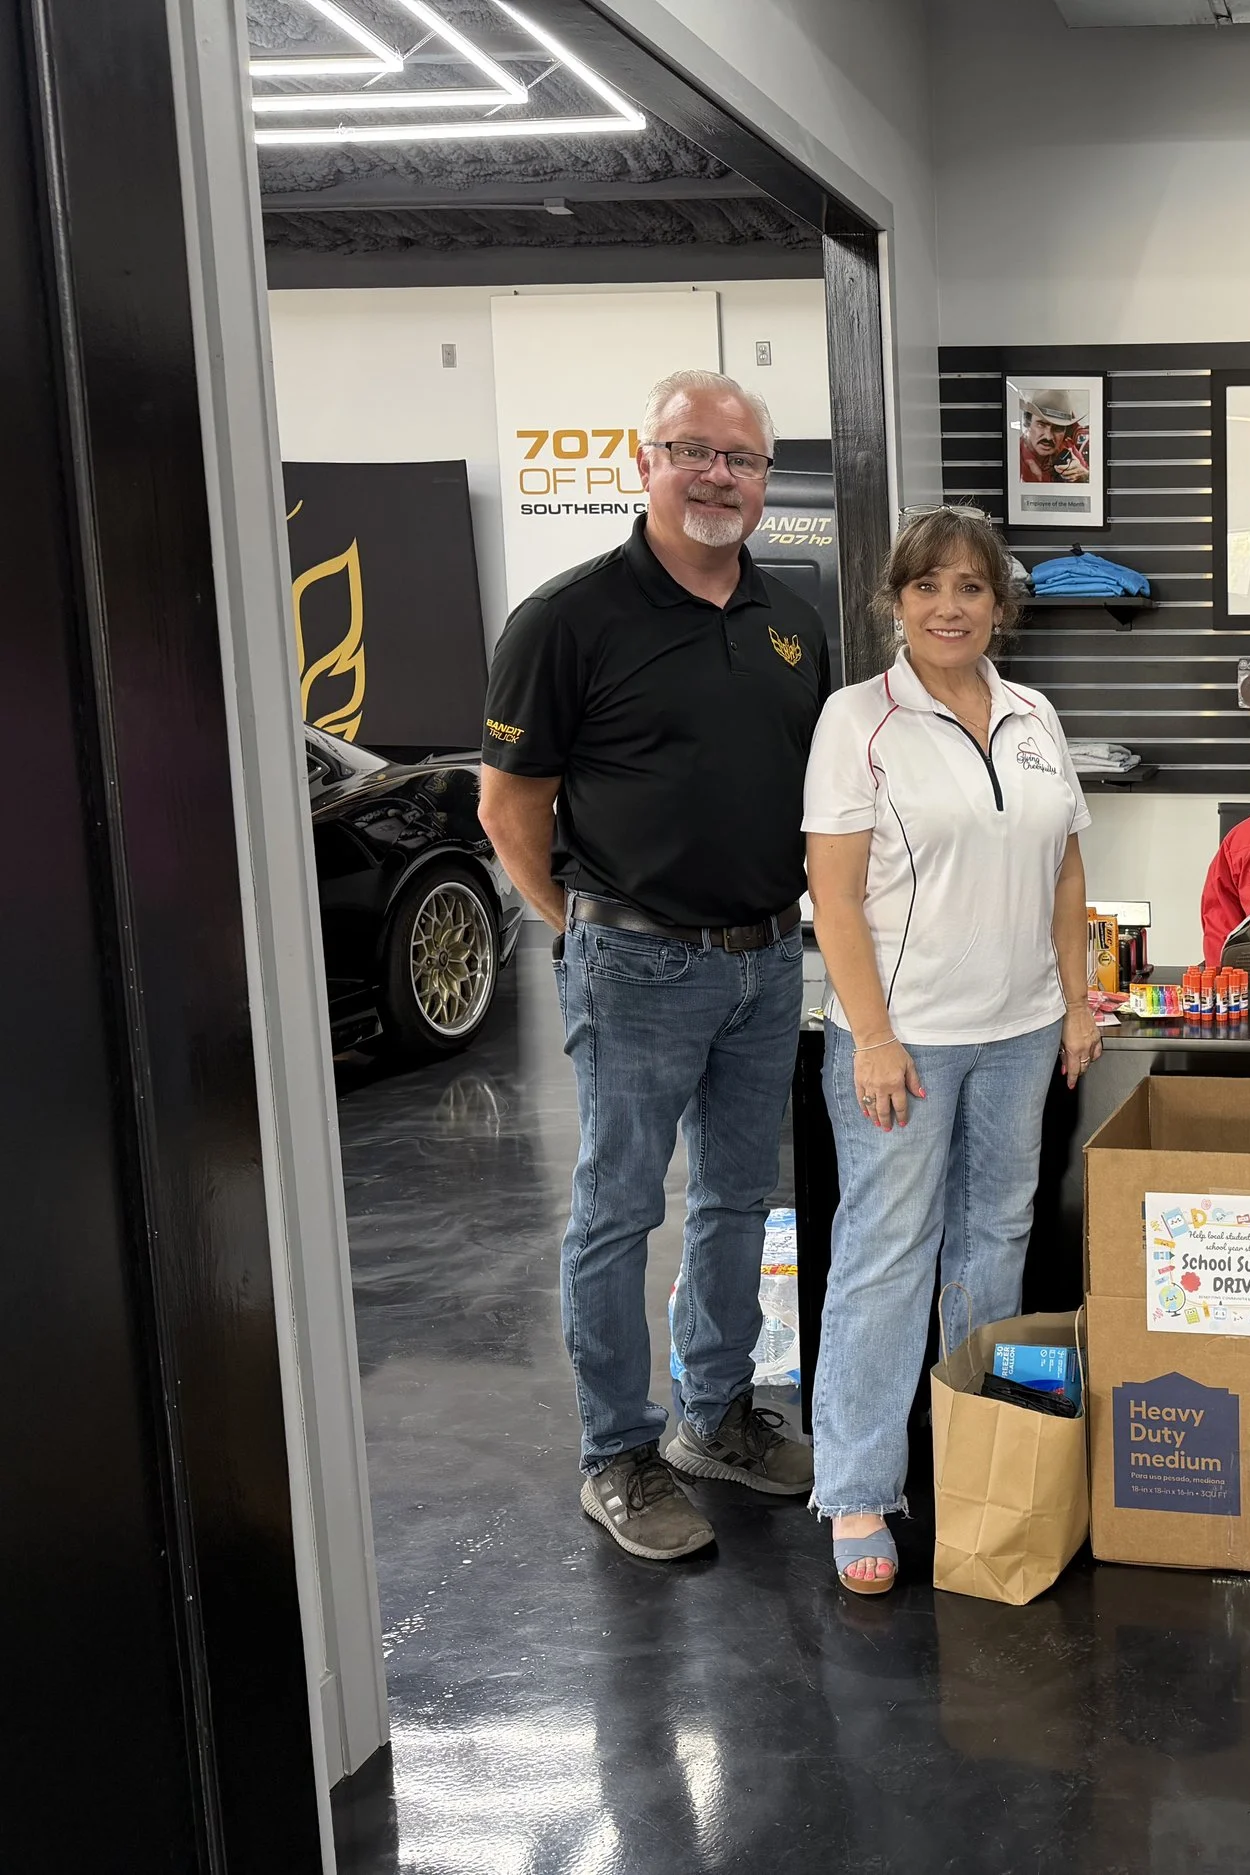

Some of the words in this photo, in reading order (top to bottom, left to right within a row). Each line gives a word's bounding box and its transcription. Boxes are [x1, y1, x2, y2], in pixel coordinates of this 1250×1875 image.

[520, 468, 576, 494] OF
[521, 503, 628, 514] SOUTHERN
[755, 517, 832, 532] ANDIT
[486, 718, 524, 736] BANDIT
[490, 728, 520, 744] TRUCK
[1188, 1230, 1206, 1242] Help
[1208, 1231, 1224, 1240] local
[1206, 1242, 1227, 1251] school
[1228, 1246, 1244, 1254] year
[1182, 1253, 1232, 1272] School
[1002, 1347, 1010, 1378] REEZER
[1130, 1400, 1204, 1427] Heavy
[1130, 1422, 1185, 1448] Duty
[1130, 1451, 1221, 1471] medium
